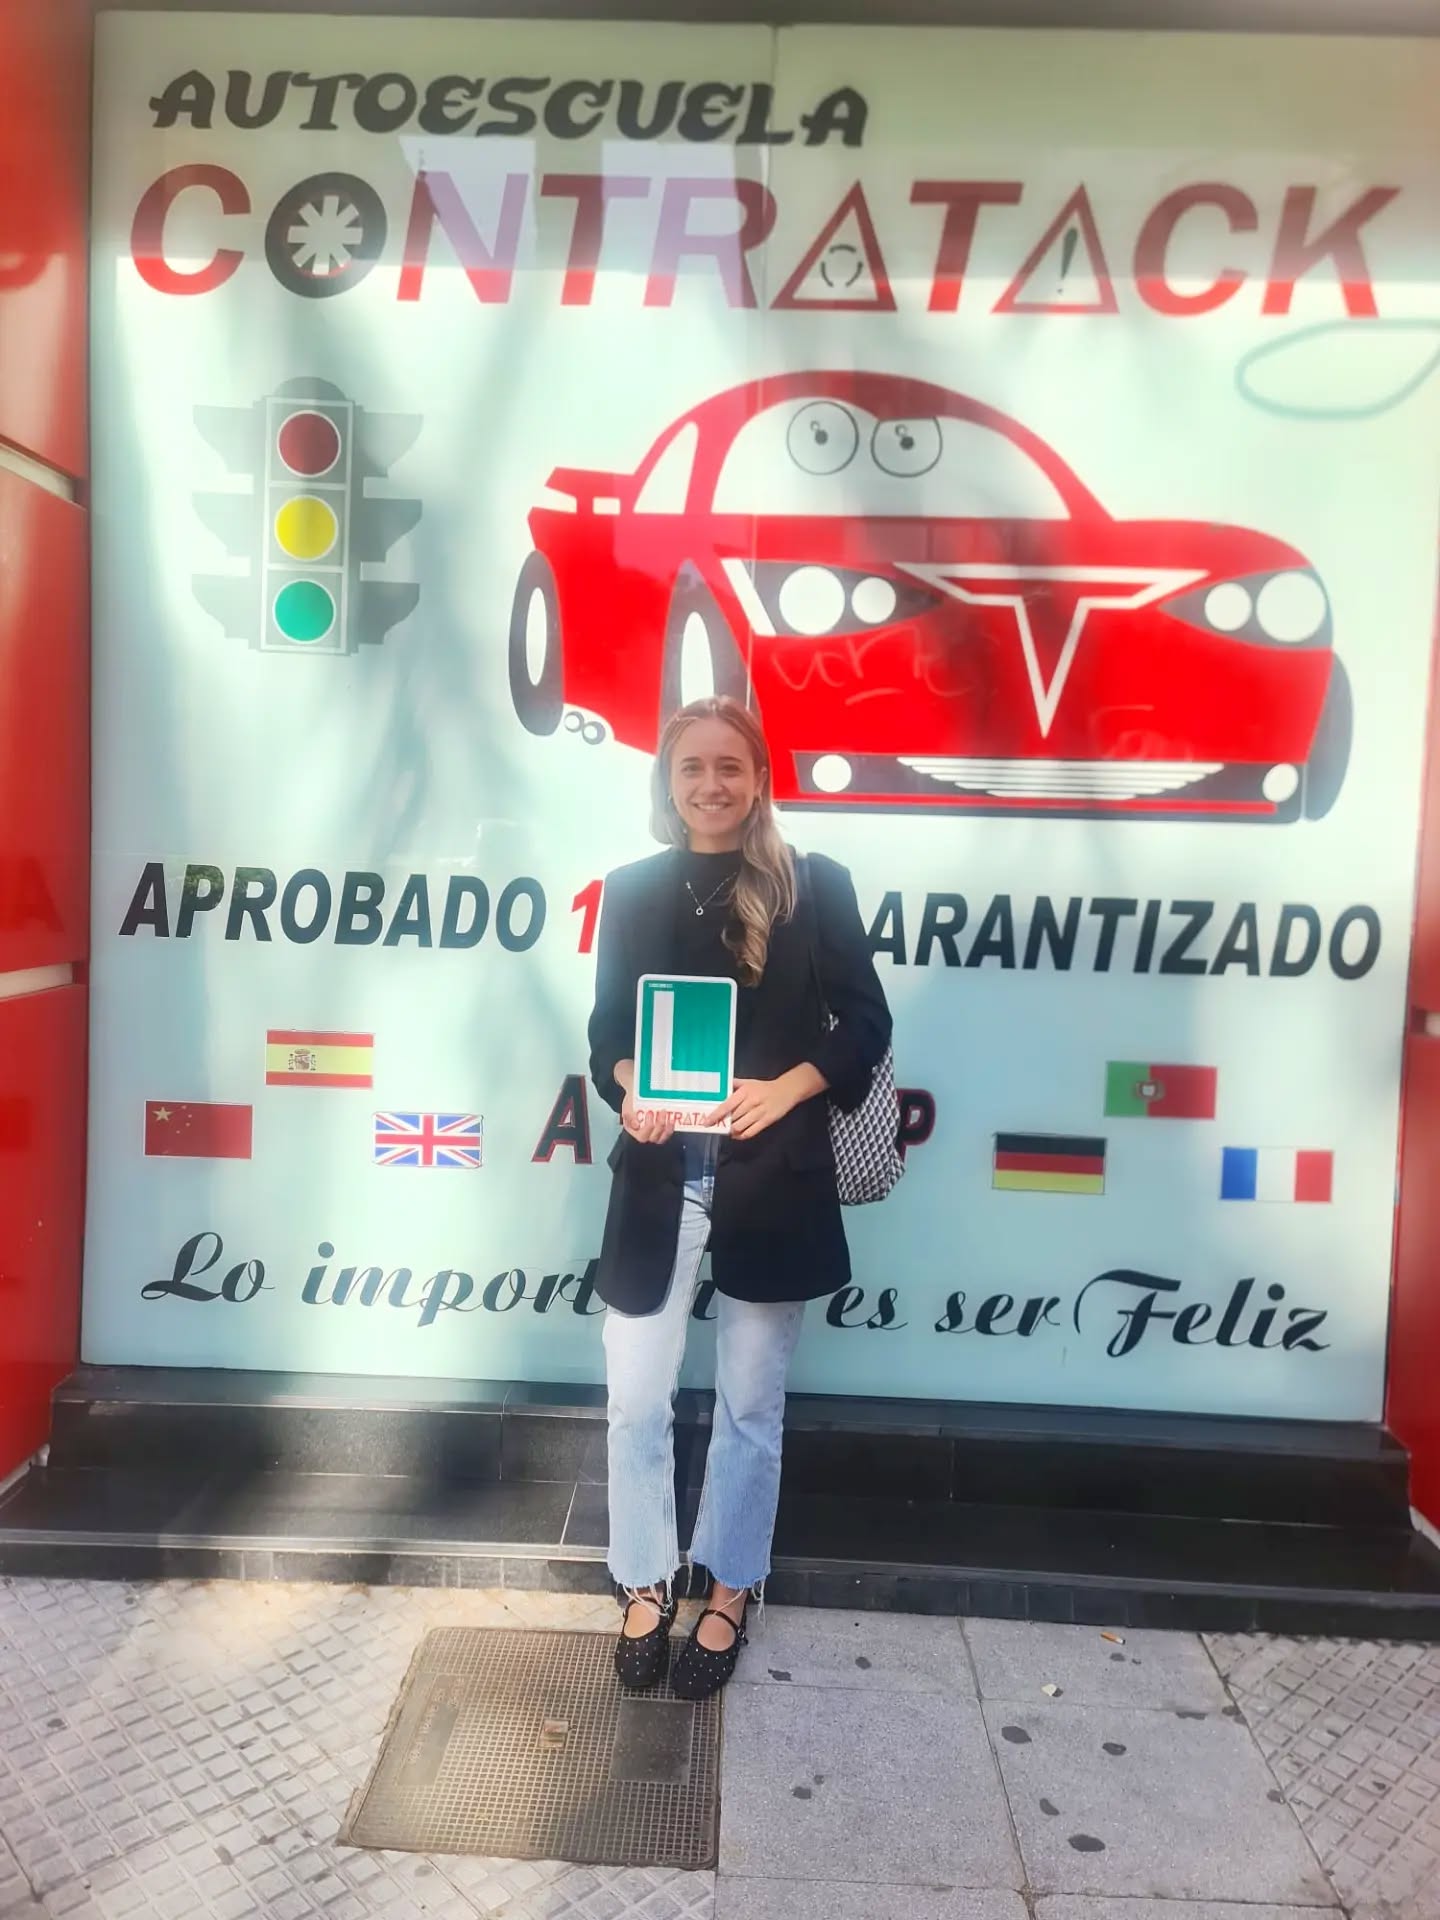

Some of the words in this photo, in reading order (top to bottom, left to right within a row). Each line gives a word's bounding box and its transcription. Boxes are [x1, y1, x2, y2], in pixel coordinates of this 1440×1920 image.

[149, 69, 868, 147] AUTOESCUELA
[130, 163, 1403, 319] CONTRATACK
[118, 862, 547, 953] APROBADO
[866, 890, 1381, 980] ARANTIZADO
[651, 990, 721, 1093] L
[141, 1231, 275, 1303] Lo
[825, 1280, 908, 1329] es
[934, 1289, 1061, 1337] ser
[1073, 1269, 1331, 1358] Feliz
